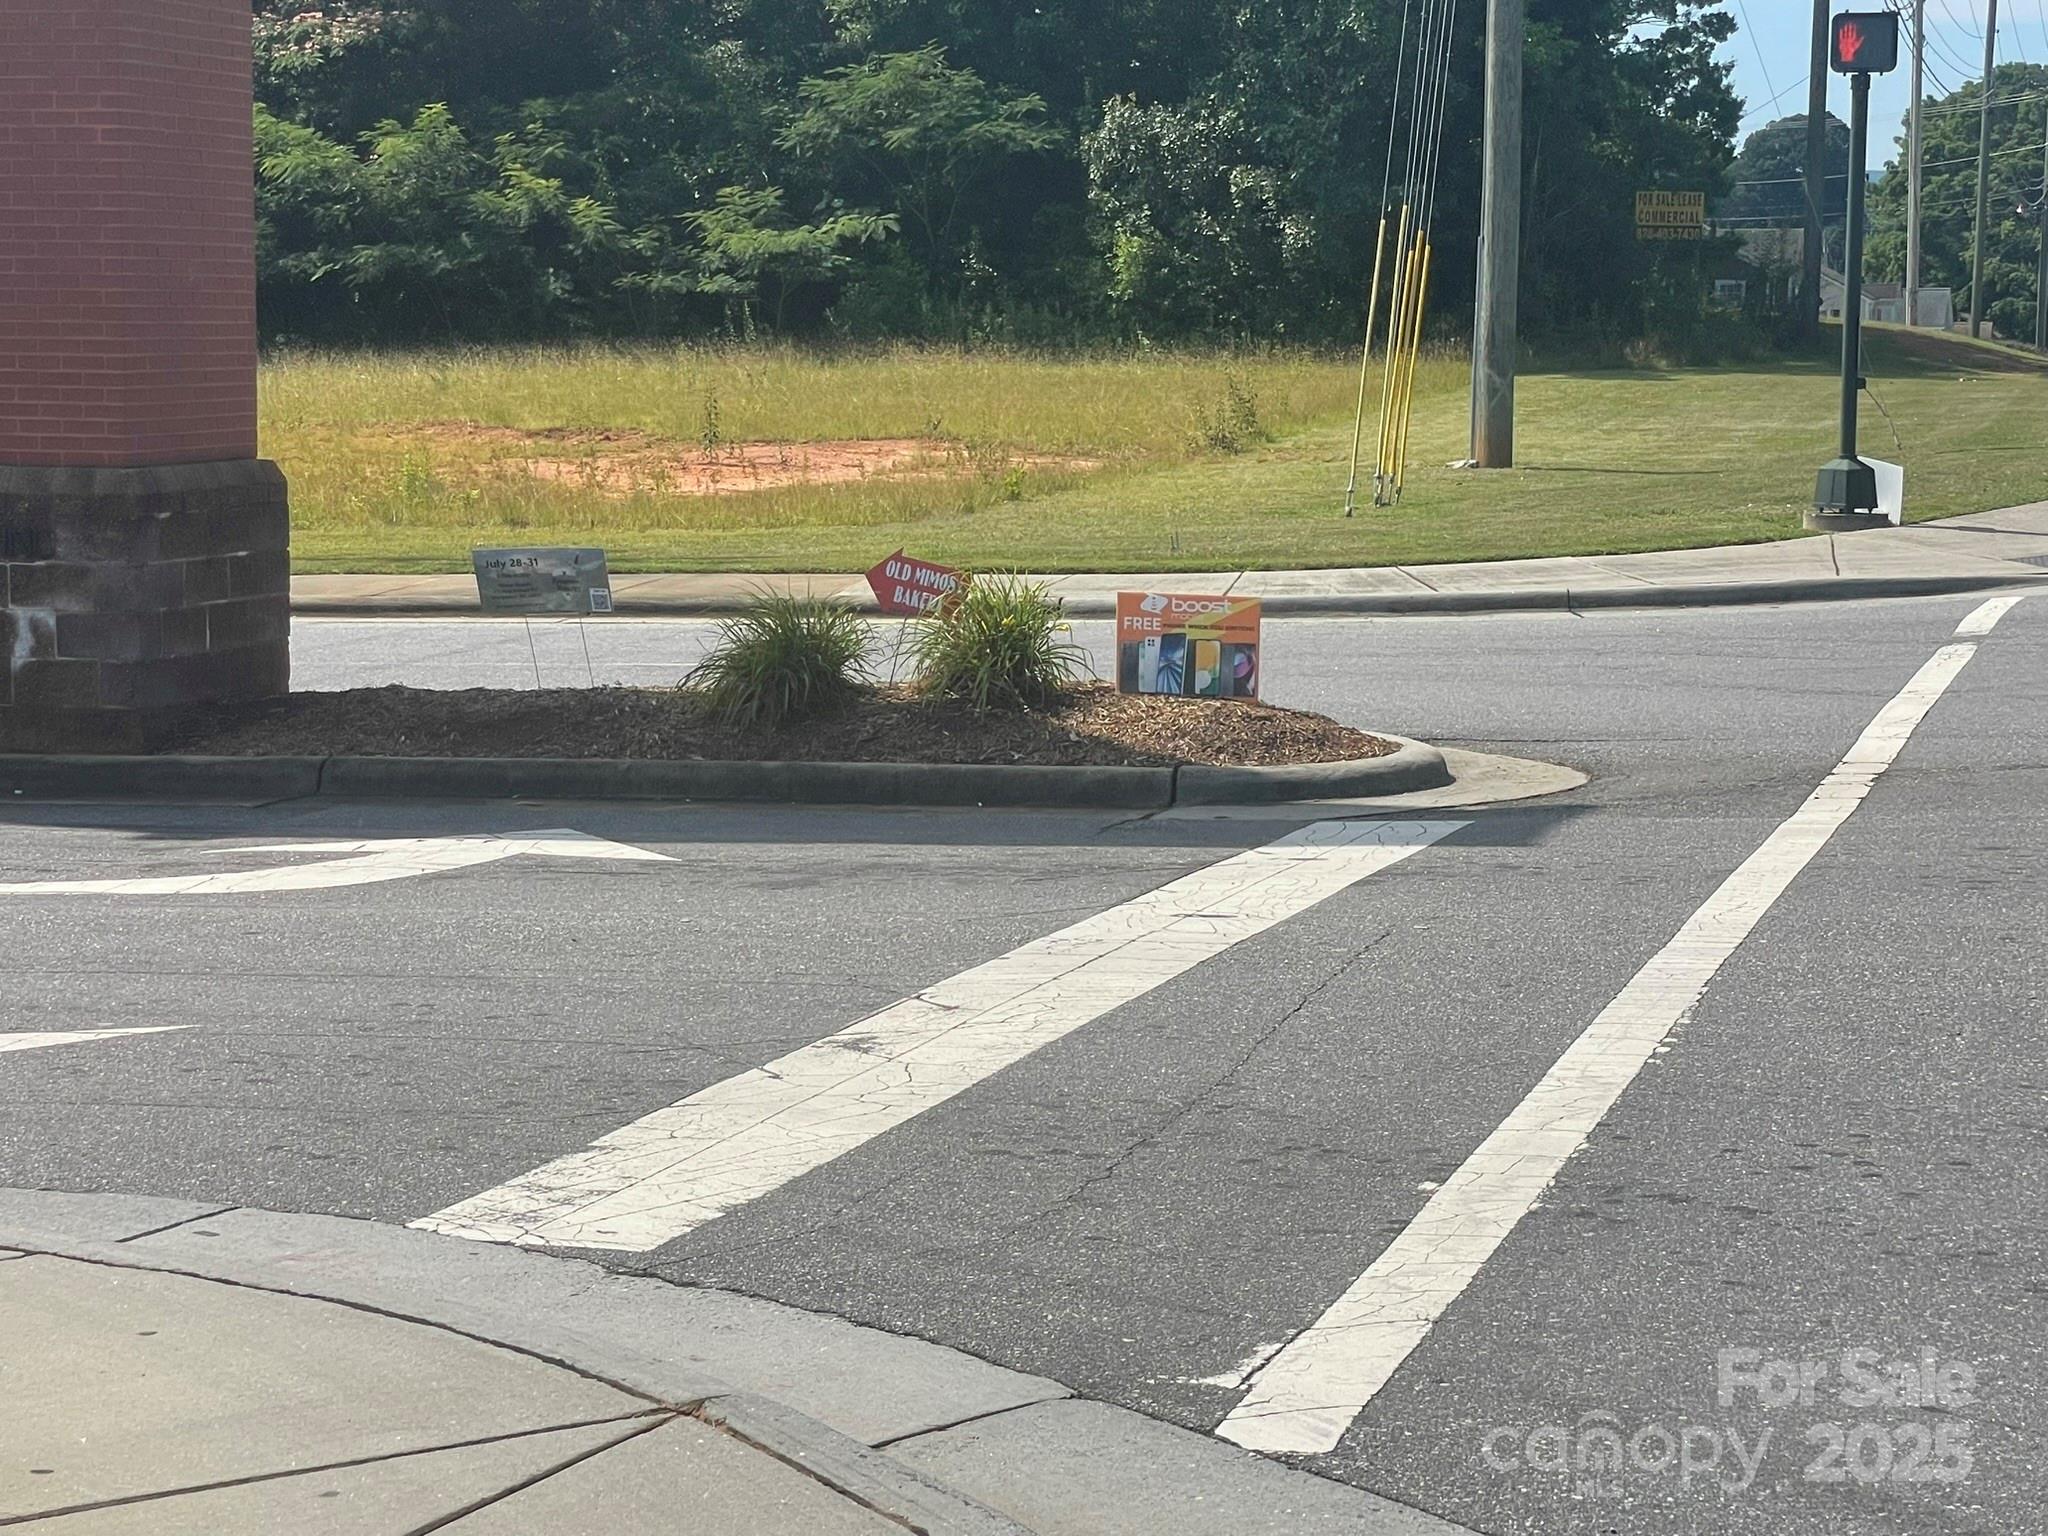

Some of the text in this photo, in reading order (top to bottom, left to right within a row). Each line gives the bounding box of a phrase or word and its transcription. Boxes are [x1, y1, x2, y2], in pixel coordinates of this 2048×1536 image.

[1638, 193, 1653, 206] FOR
[1656, 193, 1675, 206] SALE
[1638, 209, 1701, 224] COMMERCIAL
[485, 557, 539, 570] July 28-31
[886, 560, 957, 593] OLD MIMOS
[1171, 597, 1232, 613] boost
[1123, 616, 1162, 631] FREE
